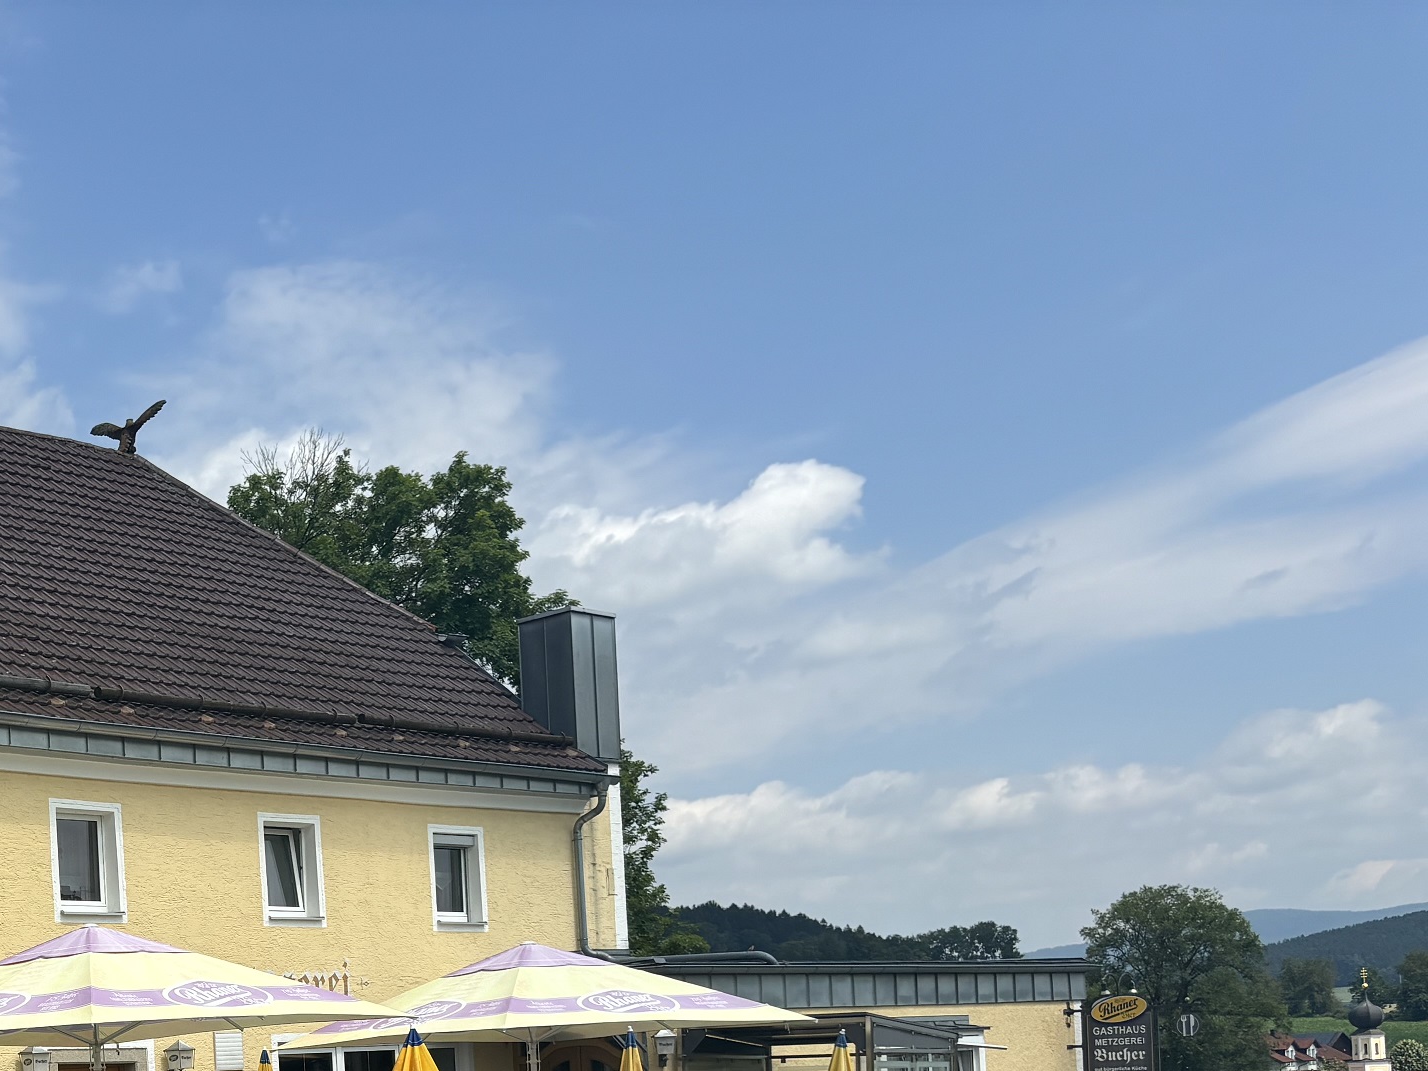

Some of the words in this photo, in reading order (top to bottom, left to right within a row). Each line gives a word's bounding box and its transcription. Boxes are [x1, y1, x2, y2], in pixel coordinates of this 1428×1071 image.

[1098, 998, 1139, 1018] Rhaner
[1093, 1025, 1146, 1035] GASTHAUS
[1094, 1037, 1145, 1046] METZGEREI
[1094, 1048, 1146, 1064] Bucher
